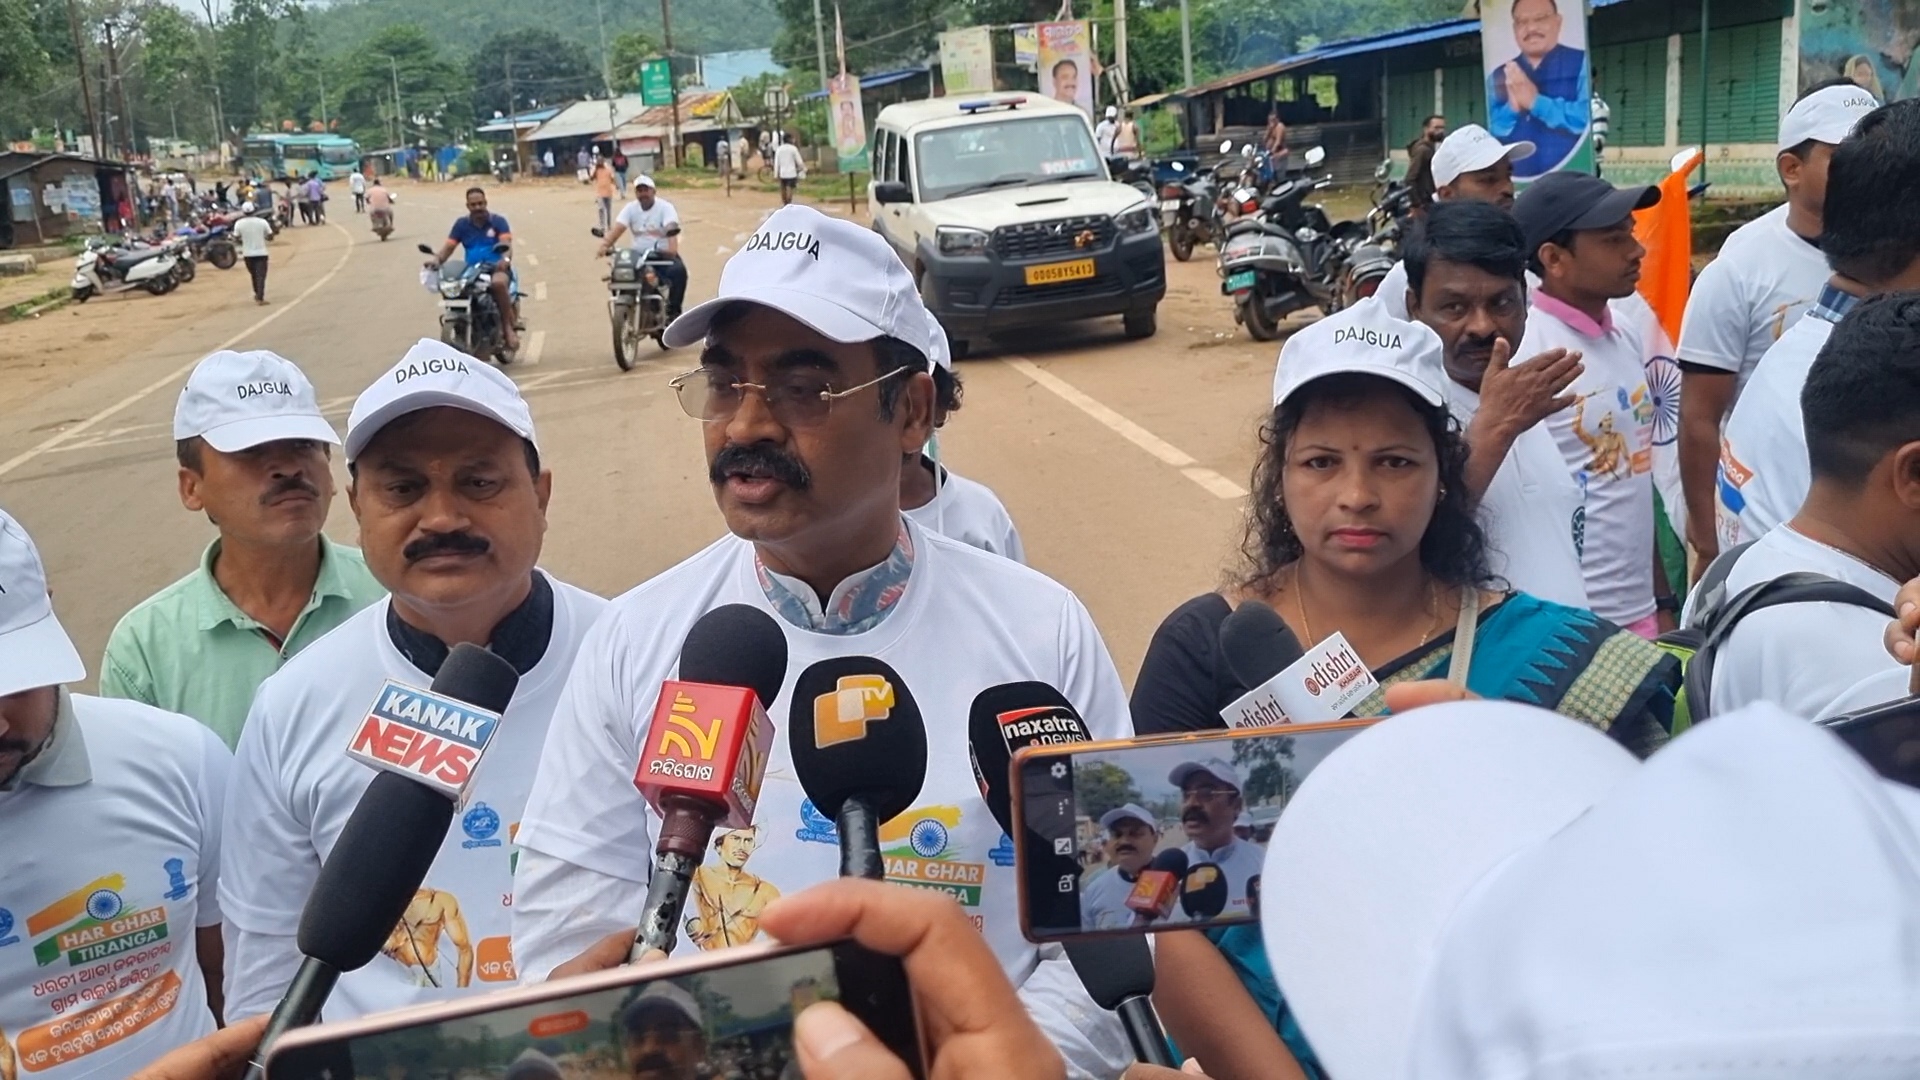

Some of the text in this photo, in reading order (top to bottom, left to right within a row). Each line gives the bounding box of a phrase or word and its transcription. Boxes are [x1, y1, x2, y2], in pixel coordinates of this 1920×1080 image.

[746, 232, 820, 261] DAJGUA
[1334, 326, 1402, 350] DAJGUA
[395, 358, 470, 384] DAJGUA
[237, 382, 293, 400] DAJGUA
[862, 683, 891, 701] TV
[382, 690, 487, 742] KANAK
[1004, 715, 1080, 739] naxatra
[352, 716, 476, 785] NEWS
[1040, 733, 1083, 746] news
[649, 758, 714, 781] ନନ୍ଦିଘୋଷ
[925, 862, 979, 882] GHAR
[62, 910, 162, 948] HAR GHAR
[78, 929, 158, 962] TIRANGA
[33, 974, 77, 998] ଧରତୀ
[79, 962, 110, 983] ଆବା
[51, 993, 79, 1015] ଗ୍ରାମ
